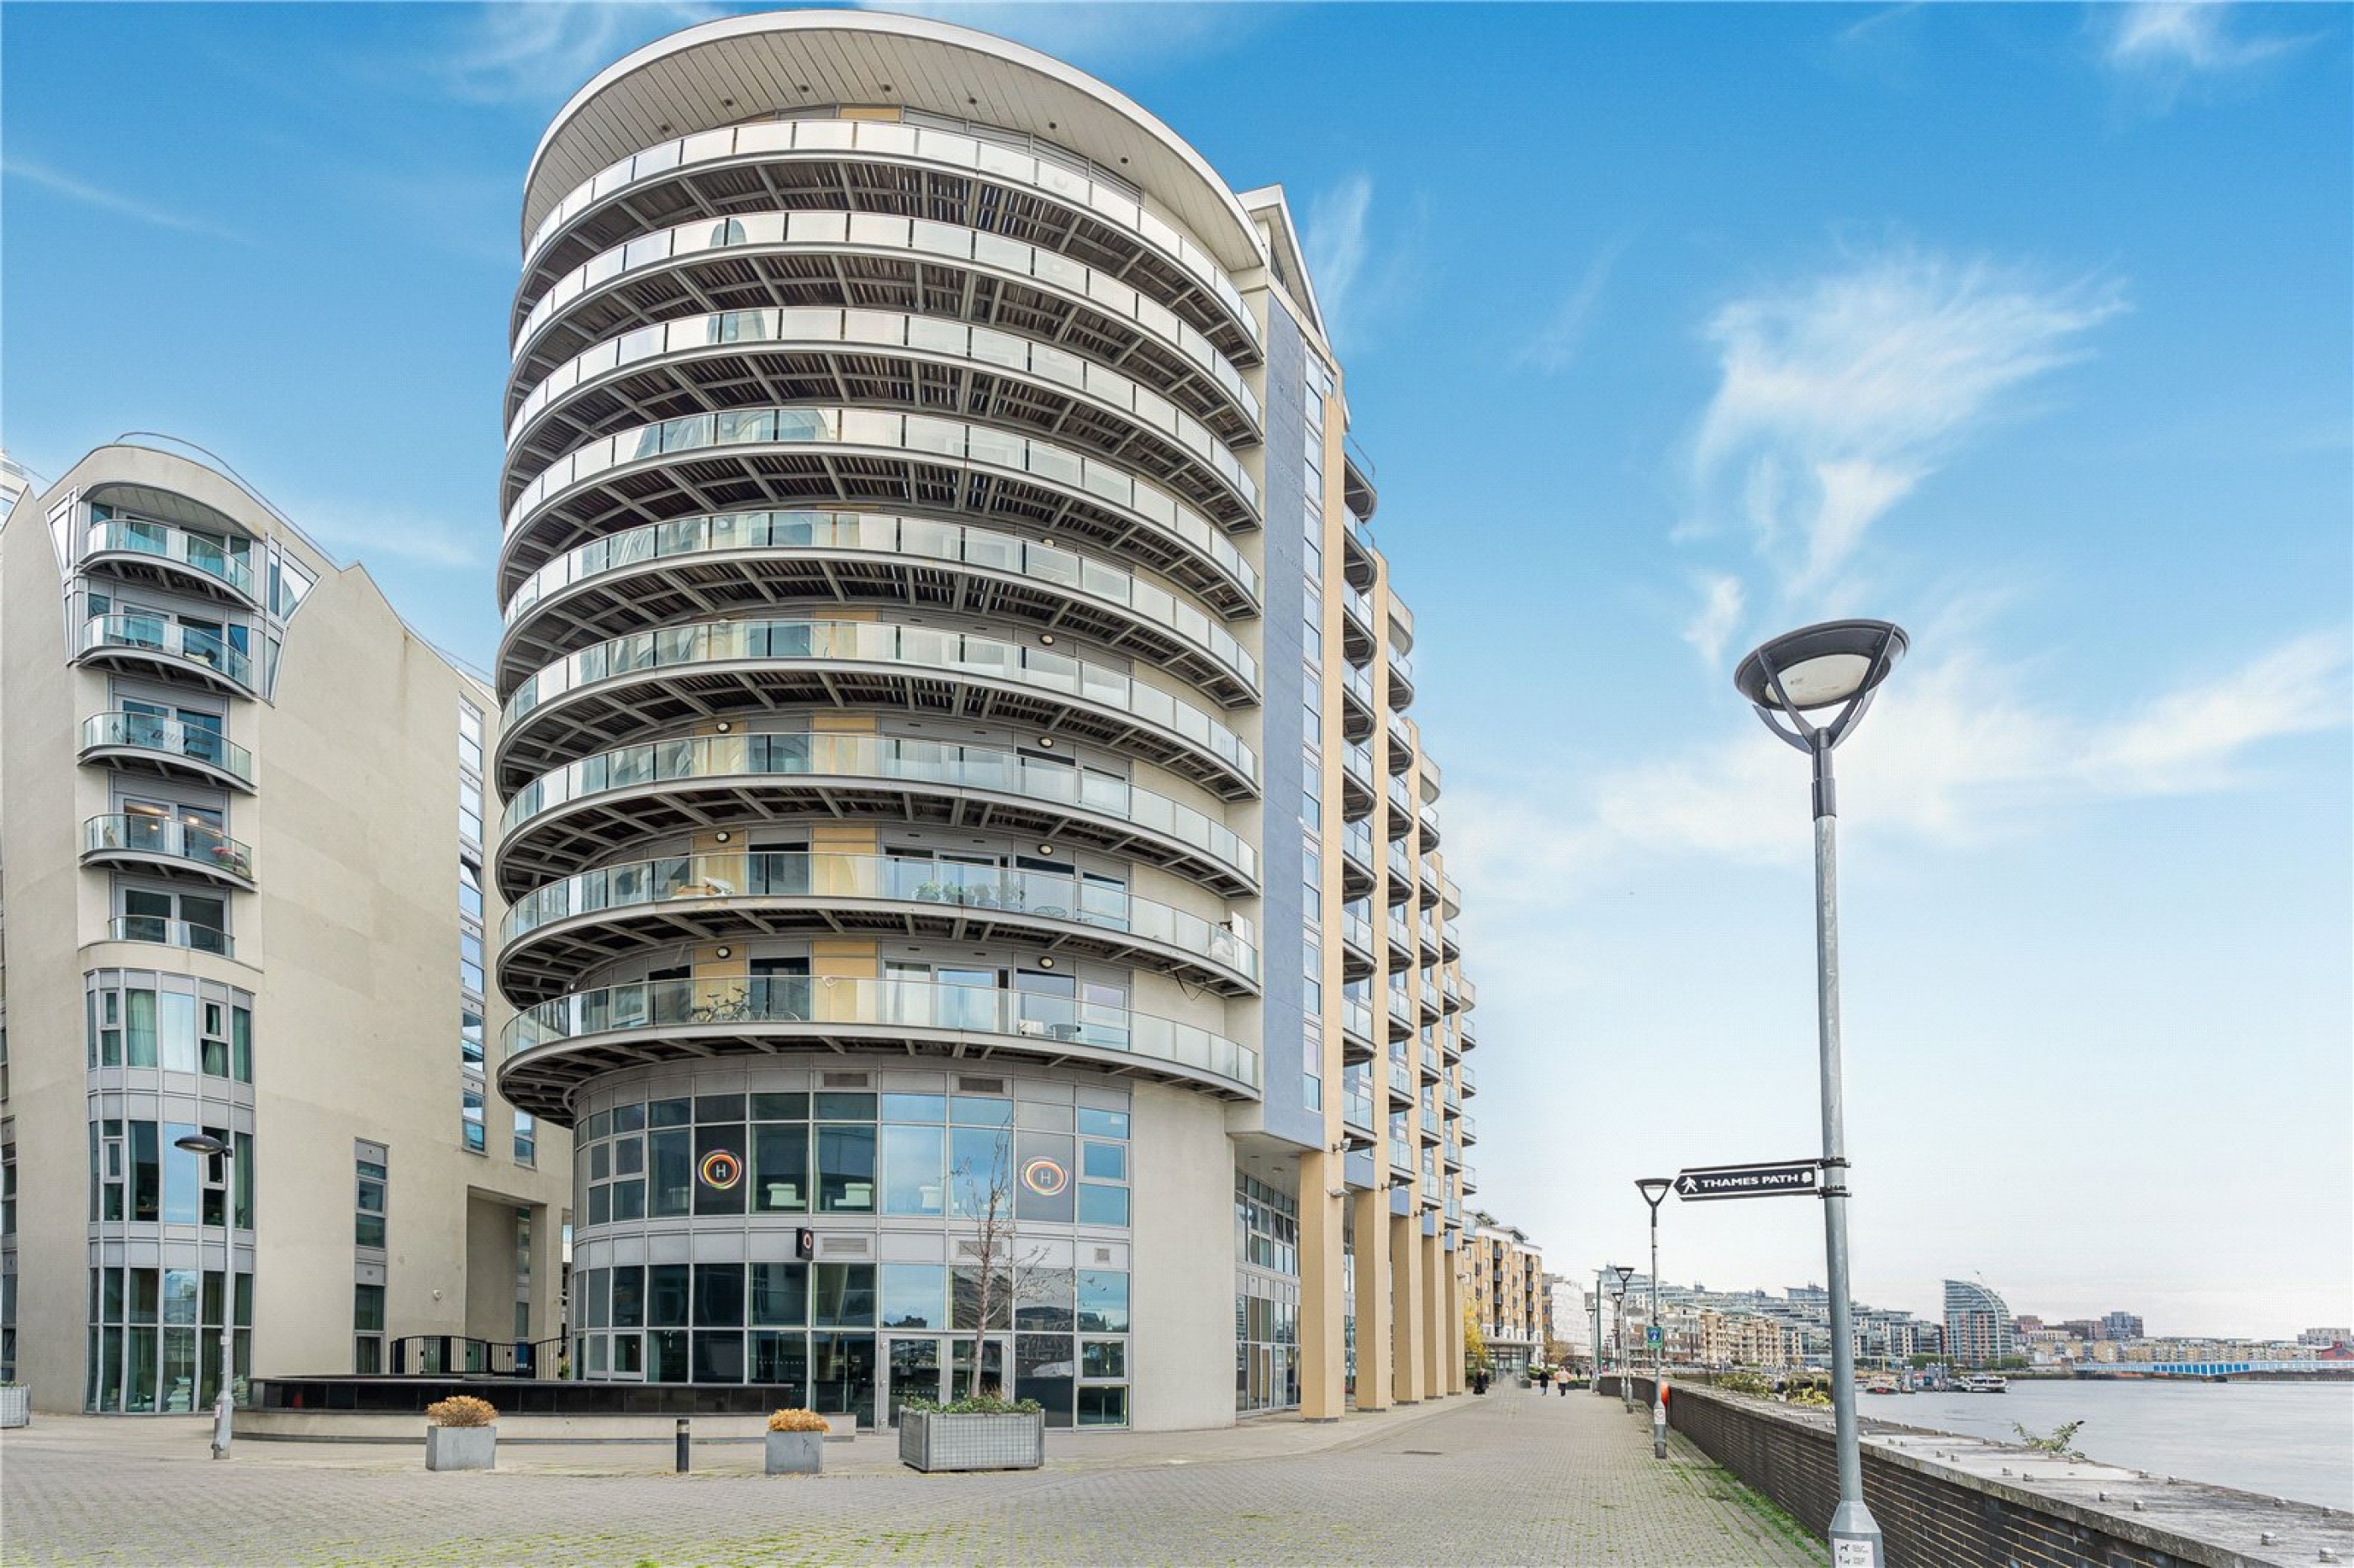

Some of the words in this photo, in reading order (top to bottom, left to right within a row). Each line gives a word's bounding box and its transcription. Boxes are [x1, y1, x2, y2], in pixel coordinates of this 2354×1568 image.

[715, 1164, 726, 1178] H
[1040, 1170, 1052, 1185] H
[1701, 1176, 1760, 1188] THAMES
[1762, 1173, 1799, 1185] PATH
